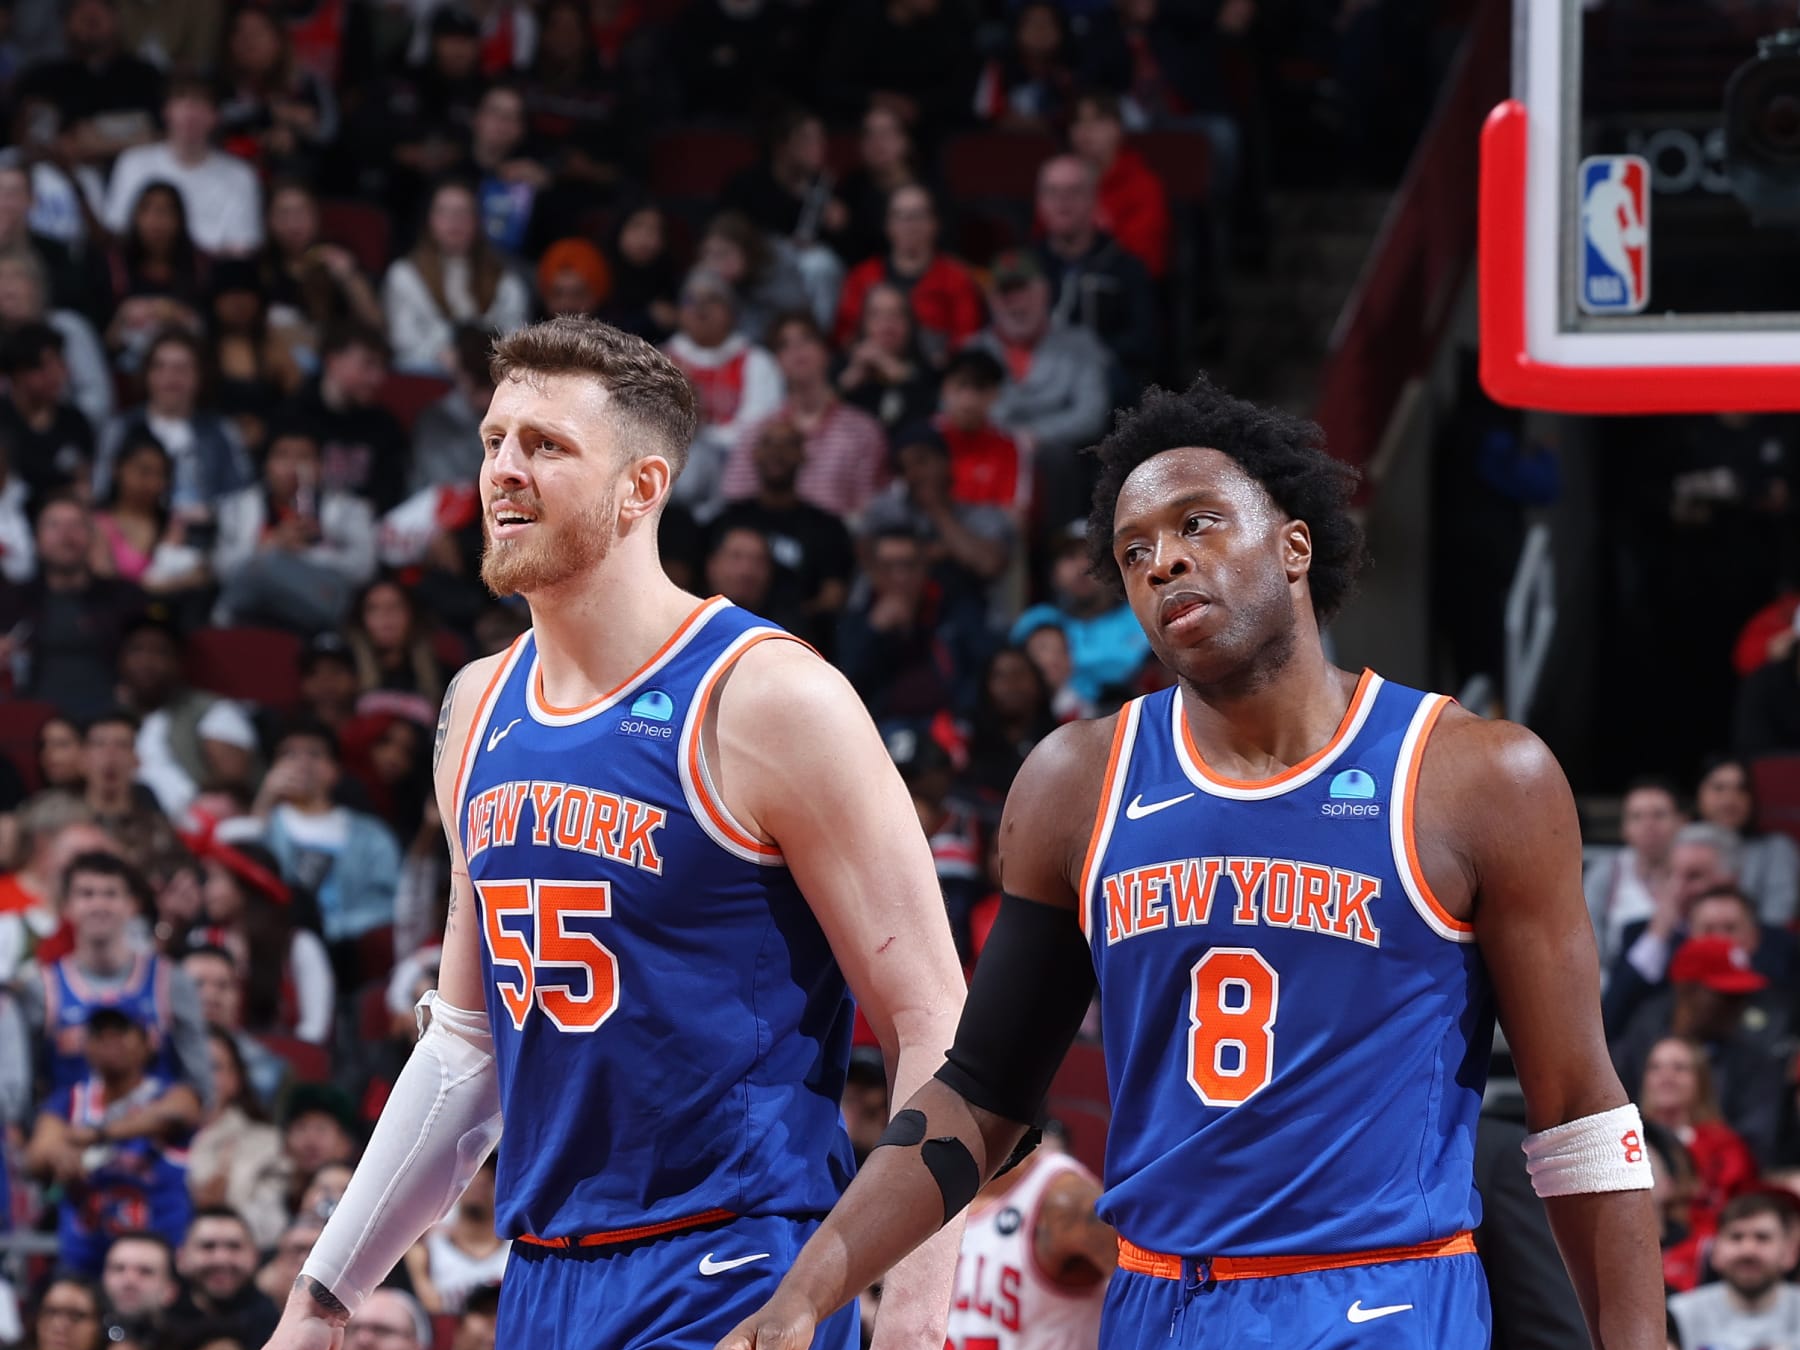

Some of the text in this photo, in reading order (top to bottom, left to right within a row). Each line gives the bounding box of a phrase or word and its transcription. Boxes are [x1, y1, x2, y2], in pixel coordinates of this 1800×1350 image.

[620, 721, 672, 738] sphere
[467, 780, 667, 877] NEW YORK
[1321, 802, 1380, 816] sphere
[1103, 856, 1382, 948] NEW YORK
[474, 879, 620, 1032] 55
[1187, 947, 1279, 1108] 8
[1621, 1130, 1642, 1163] 8
[951, 1256, 1022, 1333] LLS
